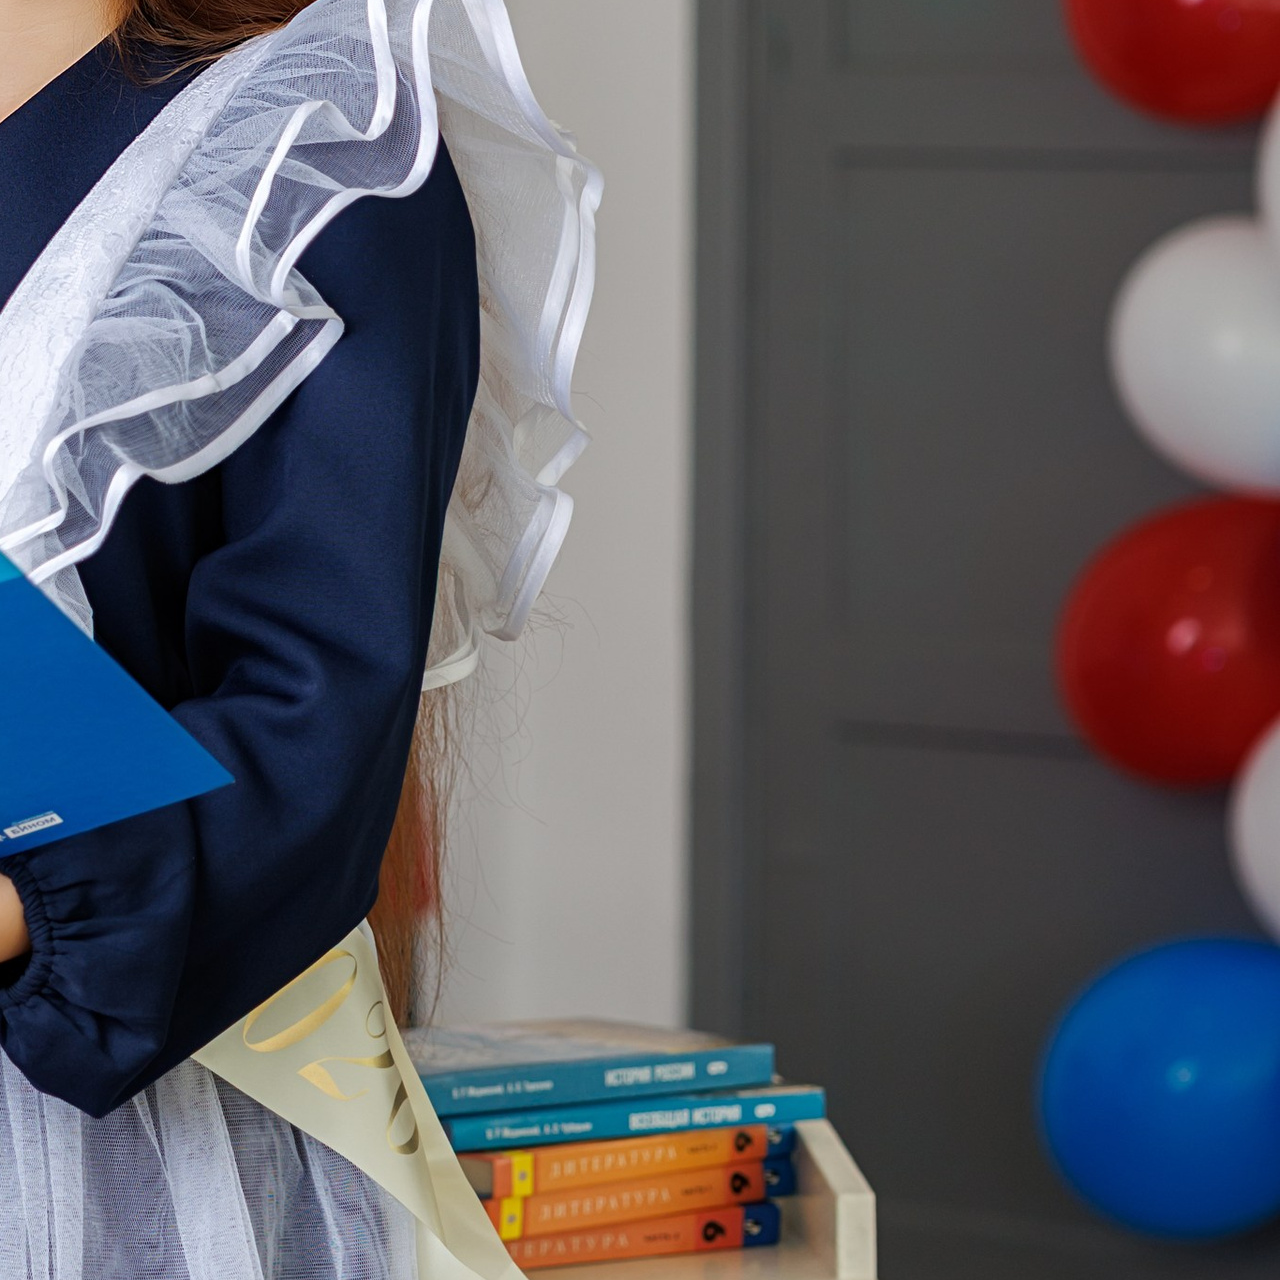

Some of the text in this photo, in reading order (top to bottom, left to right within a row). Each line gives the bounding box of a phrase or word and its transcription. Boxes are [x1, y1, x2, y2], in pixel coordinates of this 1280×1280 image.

[10, 816, 57, 835] БИНОМ
[549, 1145, 678, 1180] ЛИТЕРАТУРА
[538, 1186, 672, 1222] ЛИТЕРАТУРА
[510, 1232, 630, 1259] ТЕРАТУРА
